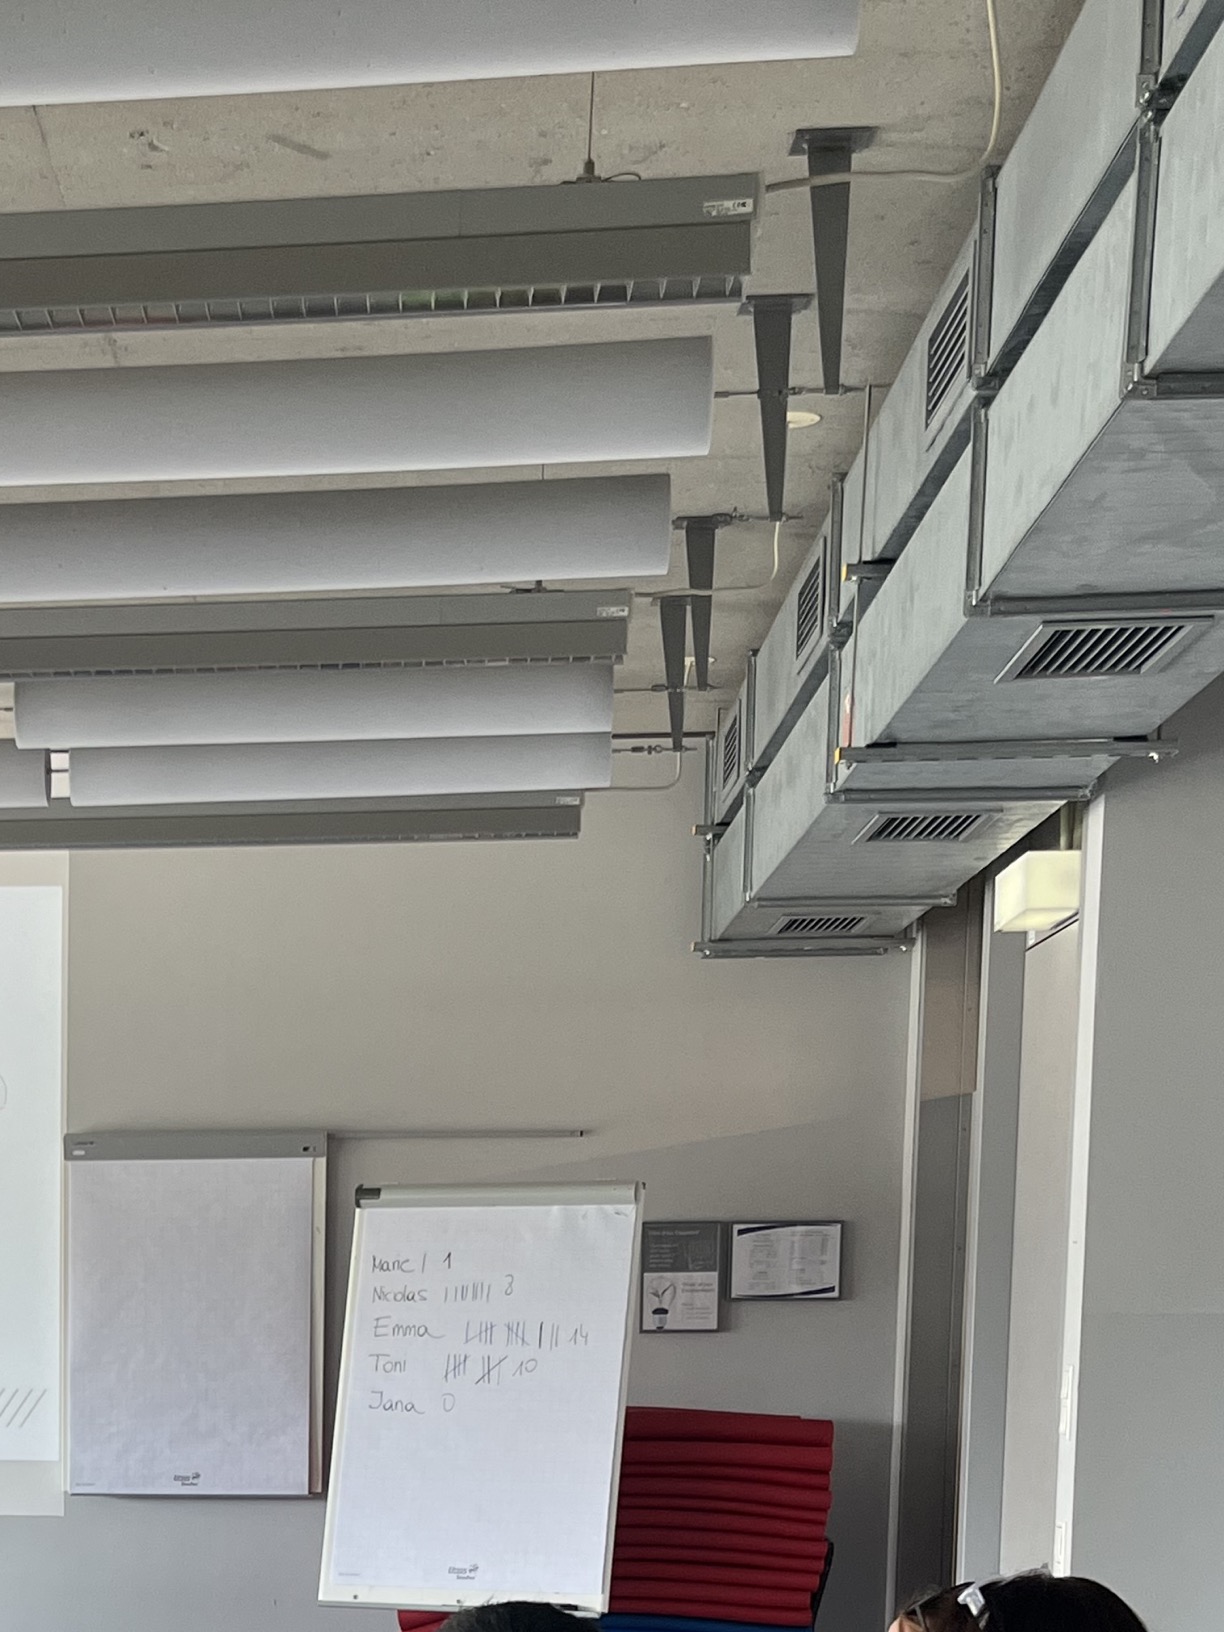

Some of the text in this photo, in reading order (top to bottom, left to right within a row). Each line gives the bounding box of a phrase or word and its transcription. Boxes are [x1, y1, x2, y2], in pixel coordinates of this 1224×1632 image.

[372, 1285, 428, 1303] Nicolas
[374, 1317, 445, 1340] Emma
[369, 1354, 538, 1377] Toni 10
[369, 1391, 425, 1415] Jana
